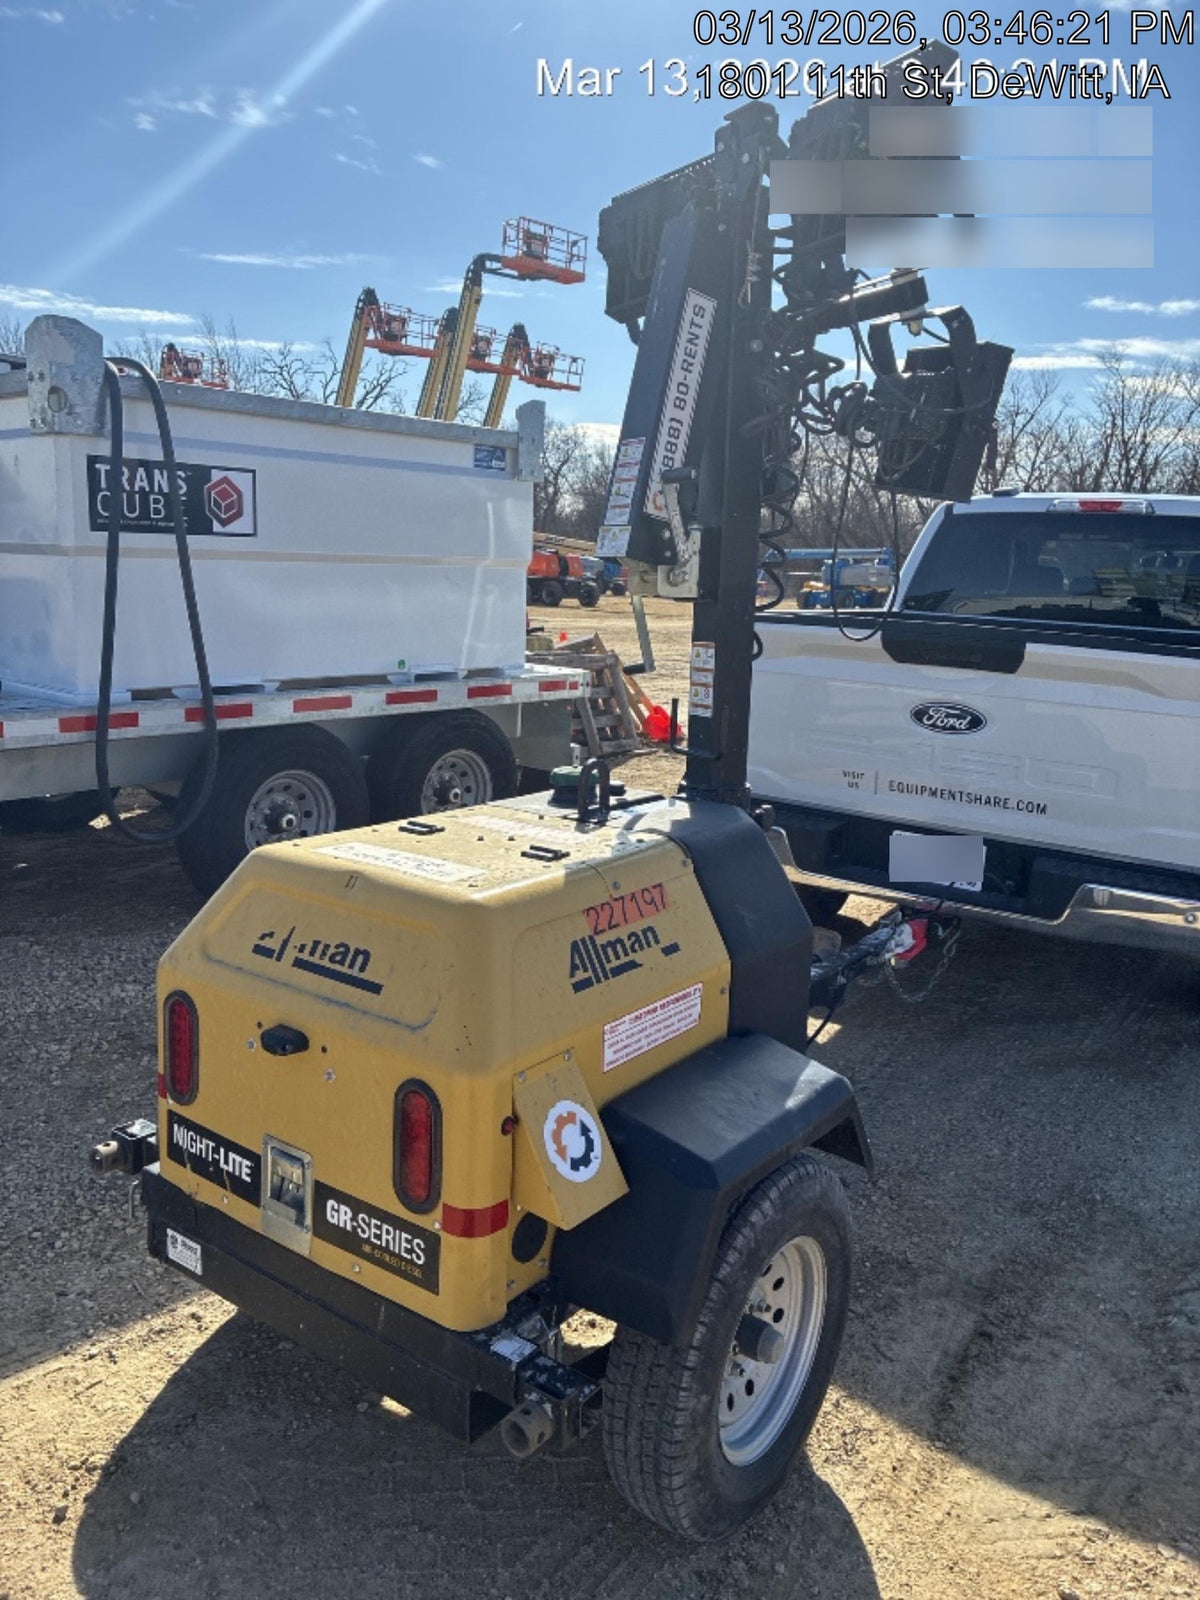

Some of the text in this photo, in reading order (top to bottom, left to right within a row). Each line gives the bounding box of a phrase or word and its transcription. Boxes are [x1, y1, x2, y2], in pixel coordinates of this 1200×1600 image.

[660, 417, 683, 474] 888)
[97, 491, 188, 521] CUB
[922, 706, 971, 730] Ford
[842, 769, 865, 780] VISIT
[847, 780, 860, 790] US
[889, 780, 1048, 815] EQUIPMENTSHARE.COM
[586, 883, 666, 935] 227197
[569, 926, 661, 984] Allman
[173, 1123, 252, 1183] NIGHT-LITE
[326, 1199, 426, 1265] GR-SERIES
